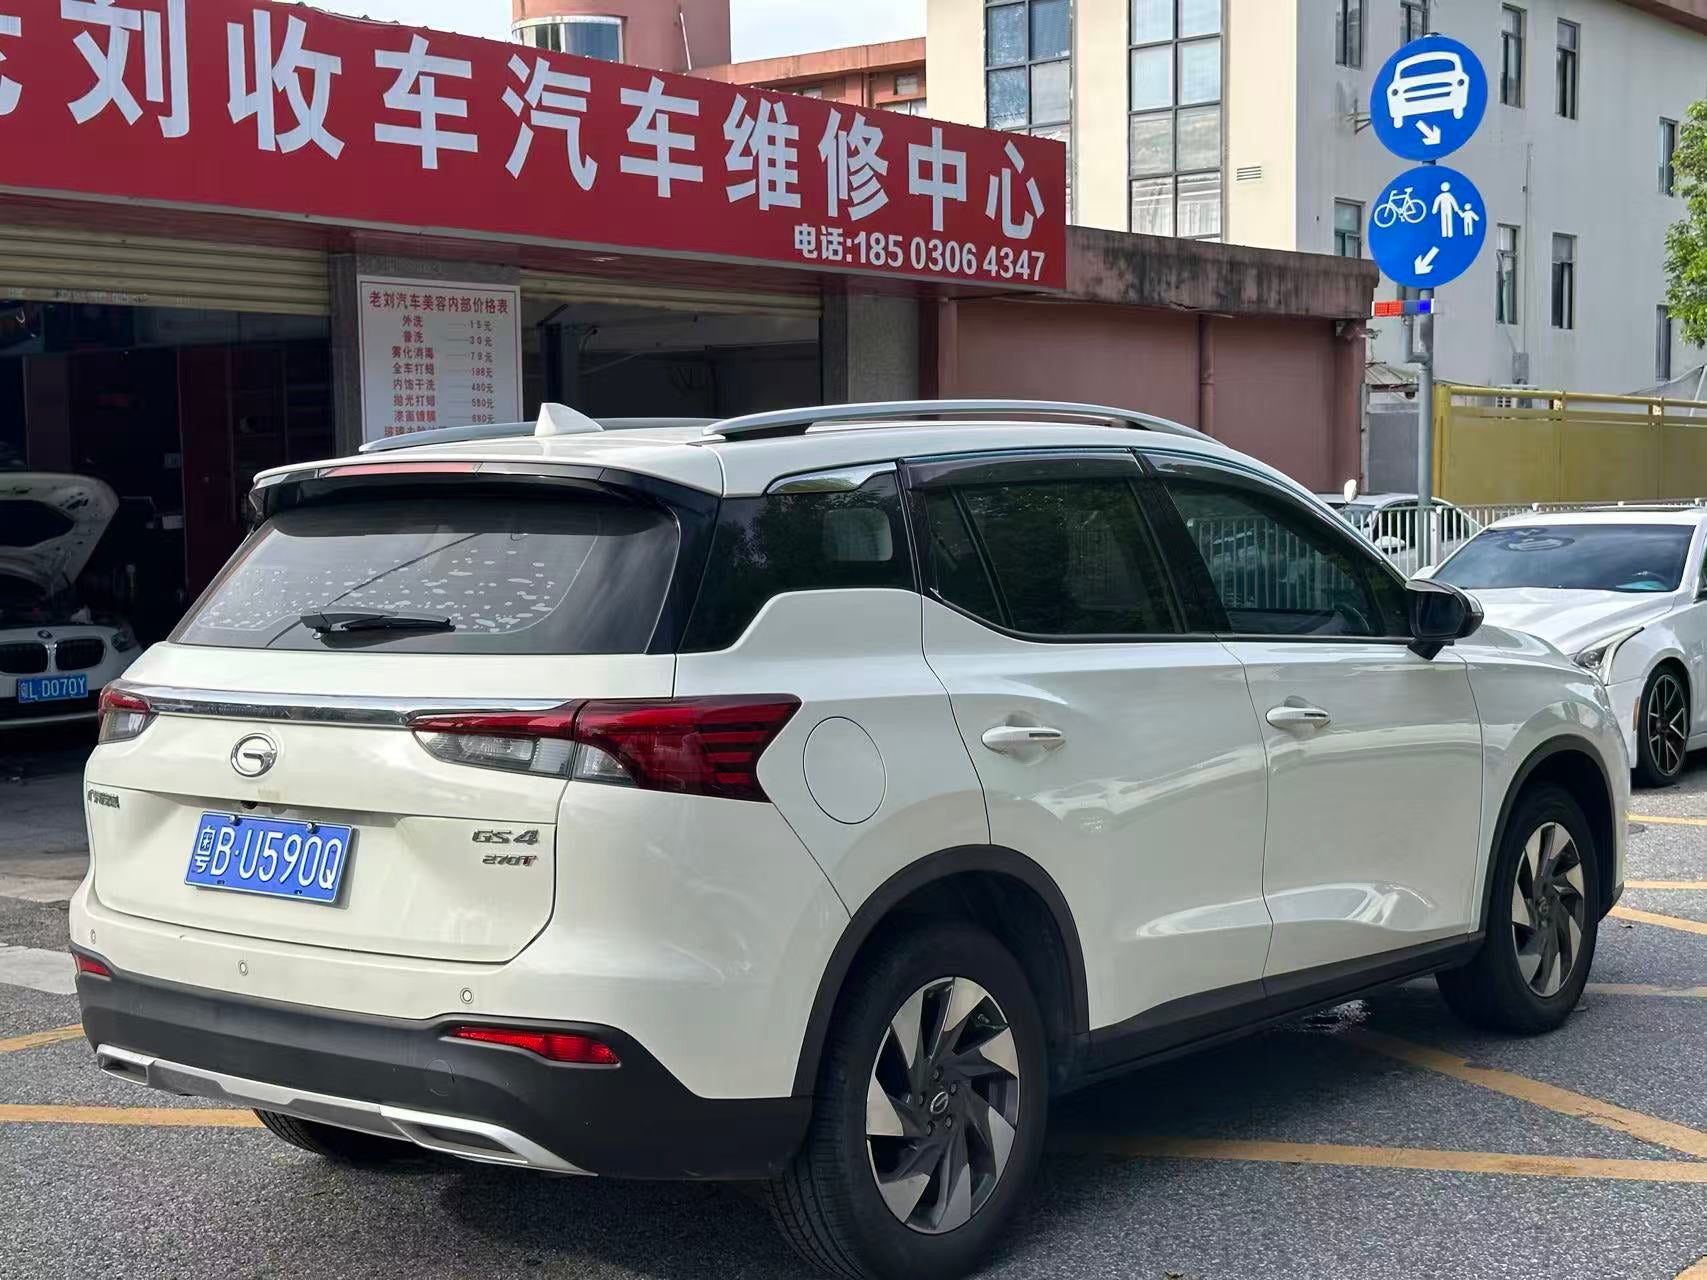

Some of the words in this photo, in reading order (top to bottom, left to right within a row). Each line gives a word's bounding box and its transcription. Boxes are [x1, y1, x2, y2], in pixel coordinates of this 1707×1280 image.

[0, 0, 1046, 240] 刘收车汽车维修中心
[910, 236, 977, 275] 0306
[982, 245, 1046, 281] 4347
[369, 289, 509, 314] 老刘汽车美容内部价格表
[402, 315, 423, 328] 外洗
[392, 363, 435, 376] 全车打蜡
[393, 379, 436, 391] 内饰干洗
[393, 395, 436, 408] 抛光打蜡
[482, 855, 537, 866] 270T
